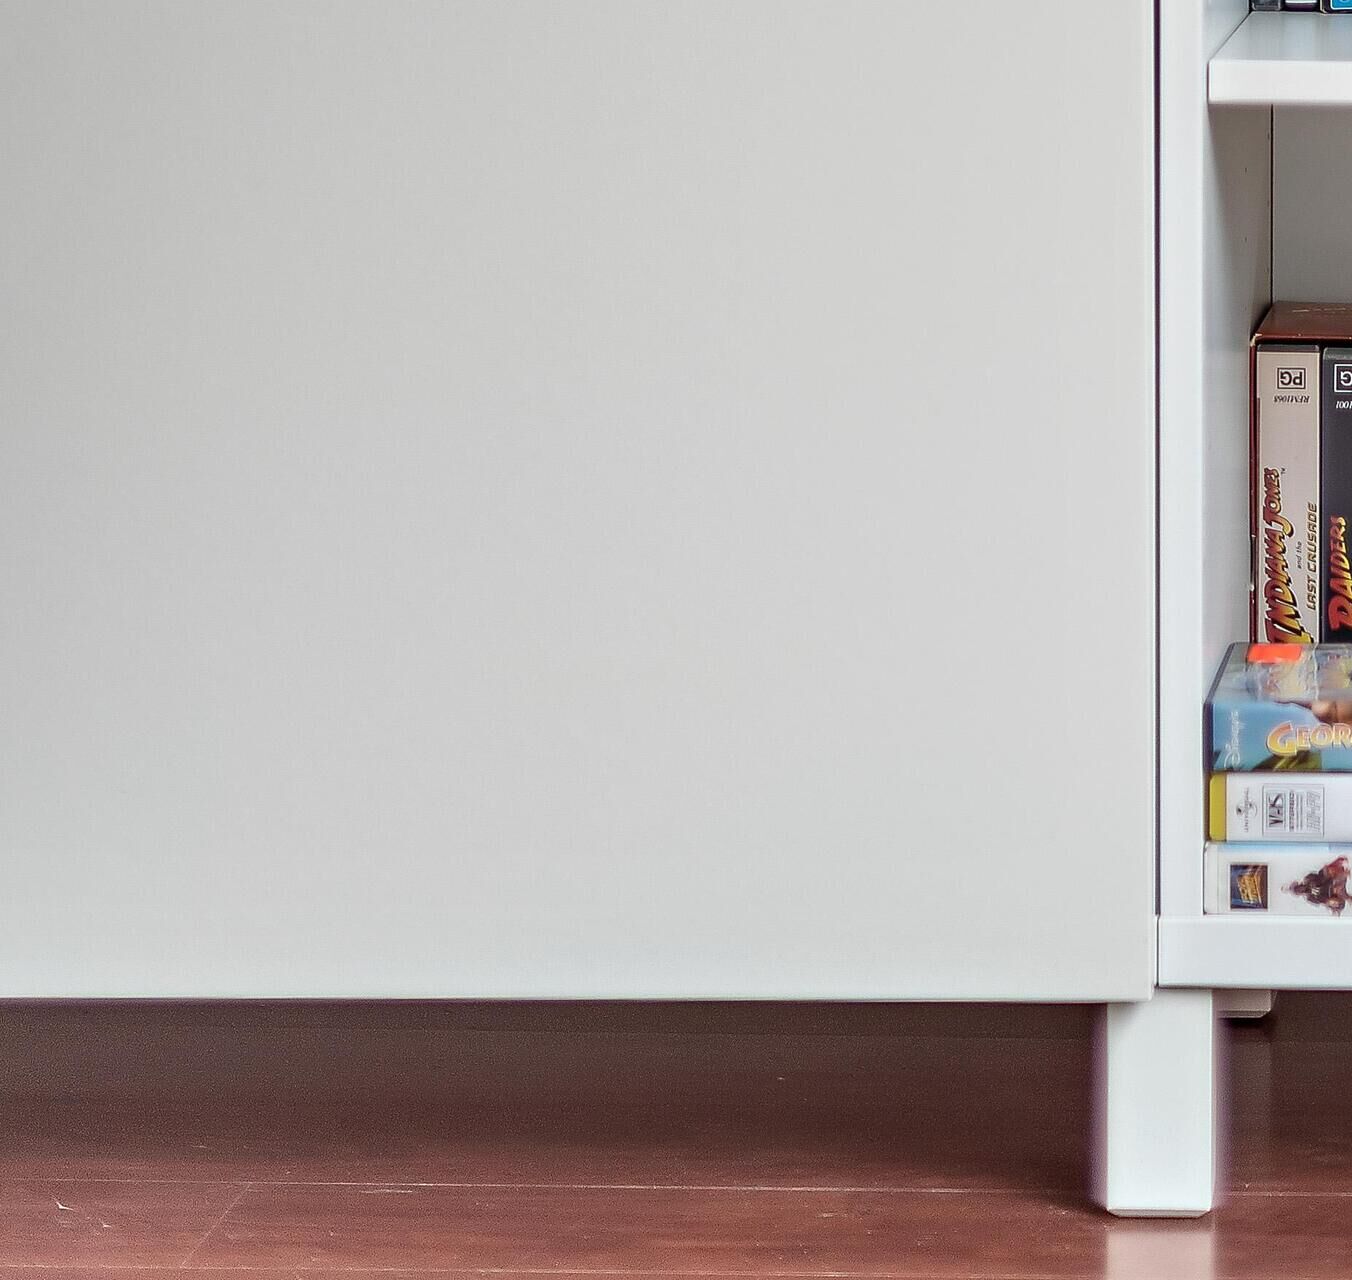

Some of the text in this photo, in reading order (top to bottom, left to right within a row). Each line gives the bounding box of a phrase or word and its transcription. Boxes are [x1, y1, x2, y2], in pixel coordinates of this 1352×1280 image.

[1263, 468, 1294, 538] JONES
[1307, 502, 1317, 610] LAST CRUSADE
